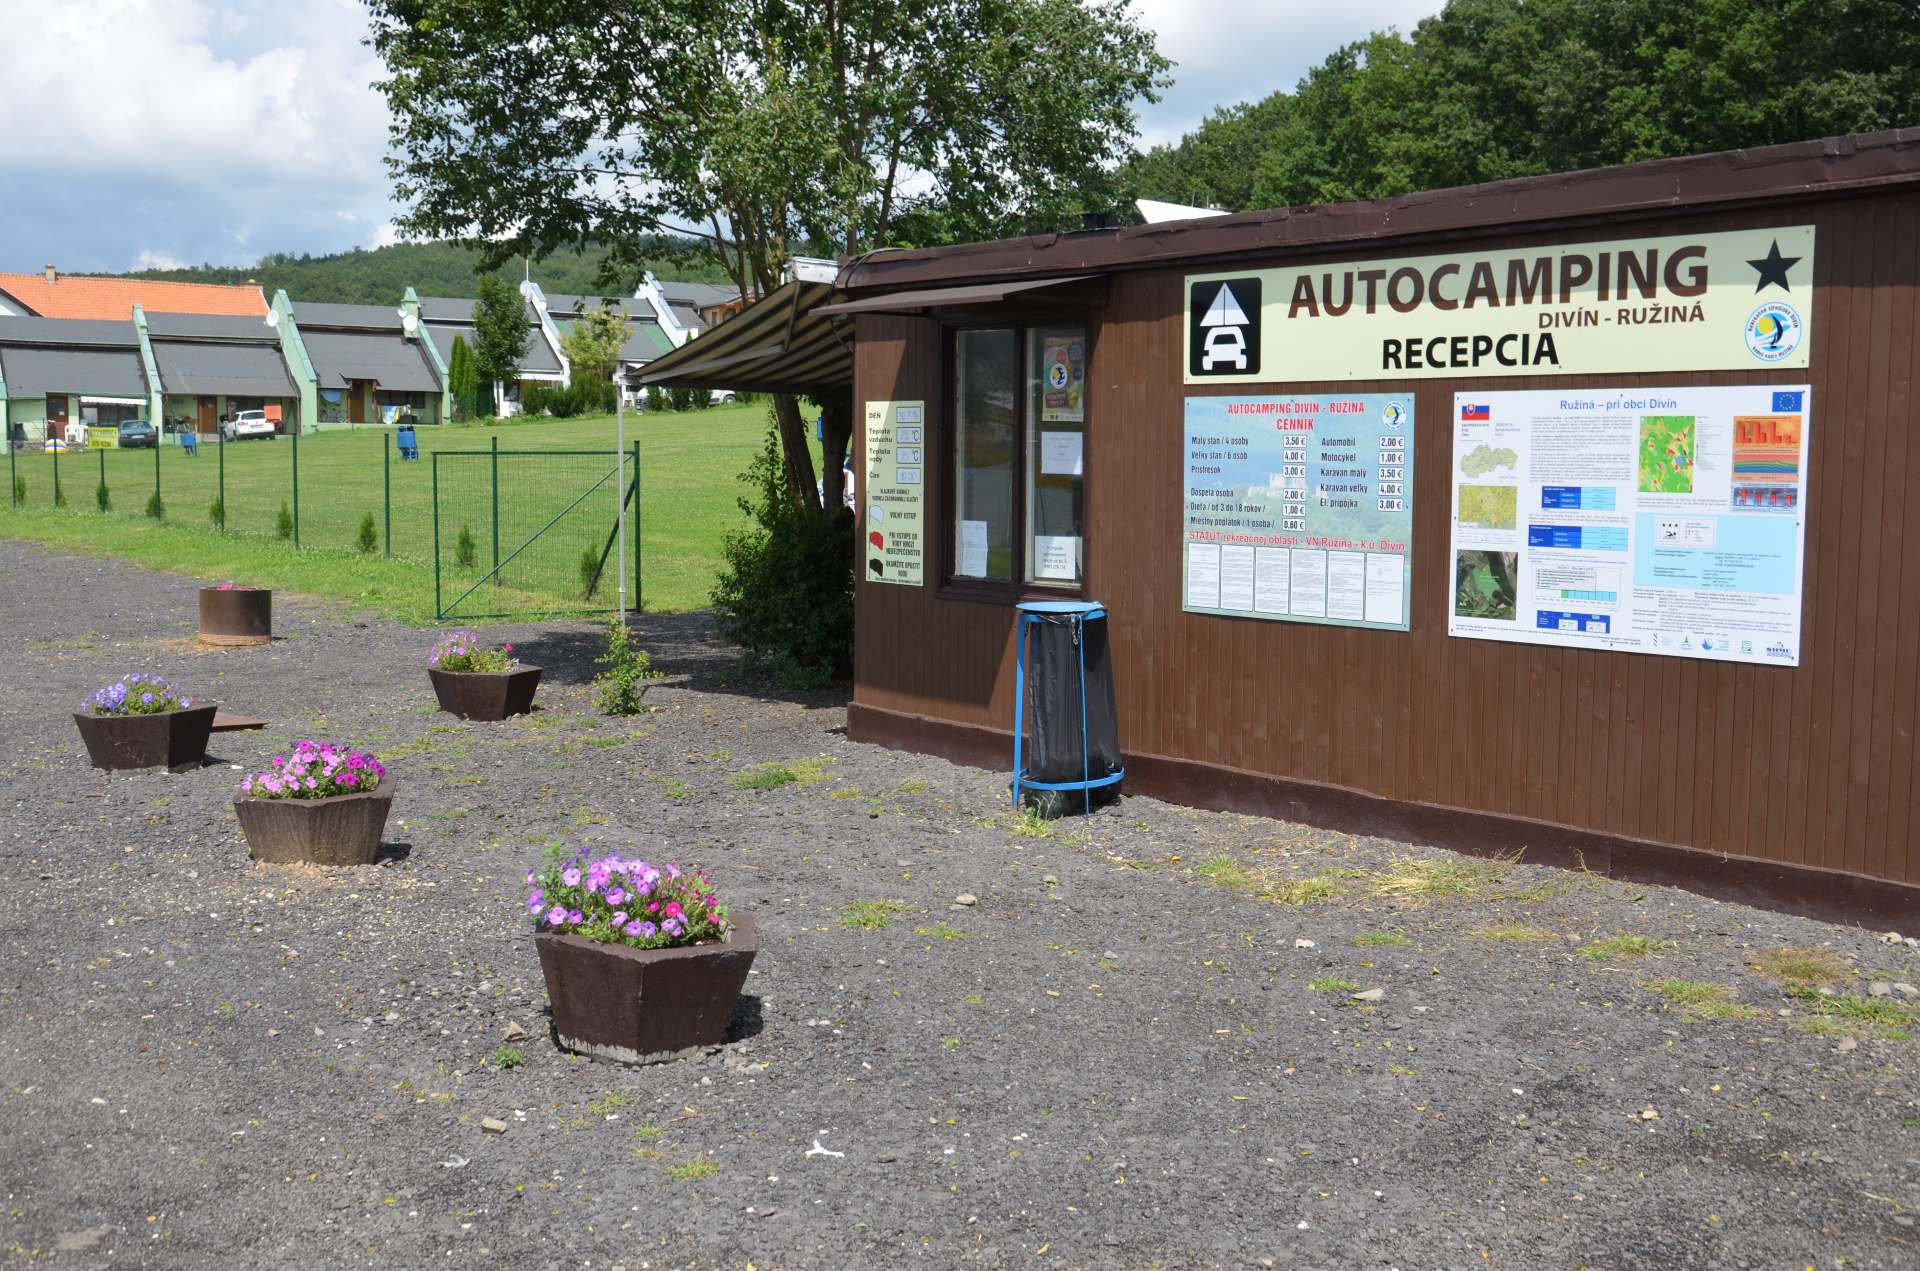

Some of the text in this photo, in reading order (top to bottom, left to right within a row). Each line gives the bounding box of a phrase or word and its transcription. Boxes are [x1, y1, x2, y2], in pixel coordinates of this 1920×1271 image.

[1288, 245, 1708, 318] AUTOCAMPING
[1538, 307, 1598, 328] DIVÍN
[1617, 301, 1705, 325] RUŽINÁ
[1383, 332, 1560, 370] RECEPCIA
[1228, 403, 1291, 414] AUTOCAMPING
[1294, 401, 1320, 414] DIVÍN
[1330, 400, 1365, 413] RUŽINÁ
[1560, 399, 1594, 410] Ružiná
[1606, 399, 1620, 411] pri
[1623, 399, 1646, 409] obci
[1649, 398, 1677, 409] Divín
[1276, 416, 1314, 430] CENNÍK
[1192, 436, 1206, 446] Malý
[1231, 437, 1249, 446] osoby
[1285, 437, 1299, 446] 3,50
[1322, 438, 1356, 446] Automobil
[1381, 438, 1396, 447] 2,00
[1191, 451, 1208, 460] Veľký
[1209, 451, 1222, 460] stan
[1285, 452, 1299, 462] 4,00
[1321, 453, 1356, 462] Motocykel
[1381, 454, 1396, 463] 1,00
[1284, 467, 1298, 476] 3,00
[1321, 468, 1367, 478] Karavan malý
[1380, 469, 1402, 478] 3,50 €
[1216, 489, 1234, 497] osoba
[1320, 483, 1368, 494] Karavan veľký
[1380, 485, 1395, 494] 4,00
[1284, 491, 1298, 500] 2,00
[1320, 498, 1328, 507] El.
[1380, 500, 1401, 510] 3,00 €
[1212, 503, 1219, 512] od
[1285, 506, 1298, 515] 1,00
[1215, 518, 1241, 527] poplatok
[1252, 520, 1271, 528] osoba
[1189, 529, 1221, 540] ŠTATÚT
[1223, 533, 1266, 545] rekreačnej
[1269, 535, 1298, 545] oblasti
[1306, 537, 1319, 546] VN
[1322, 538, 1352, 548] Ružiná
[886, 547, 920, 556] NEBEZPEČENSTVO
[886, 560, 904, 568] OKAMŽITE
